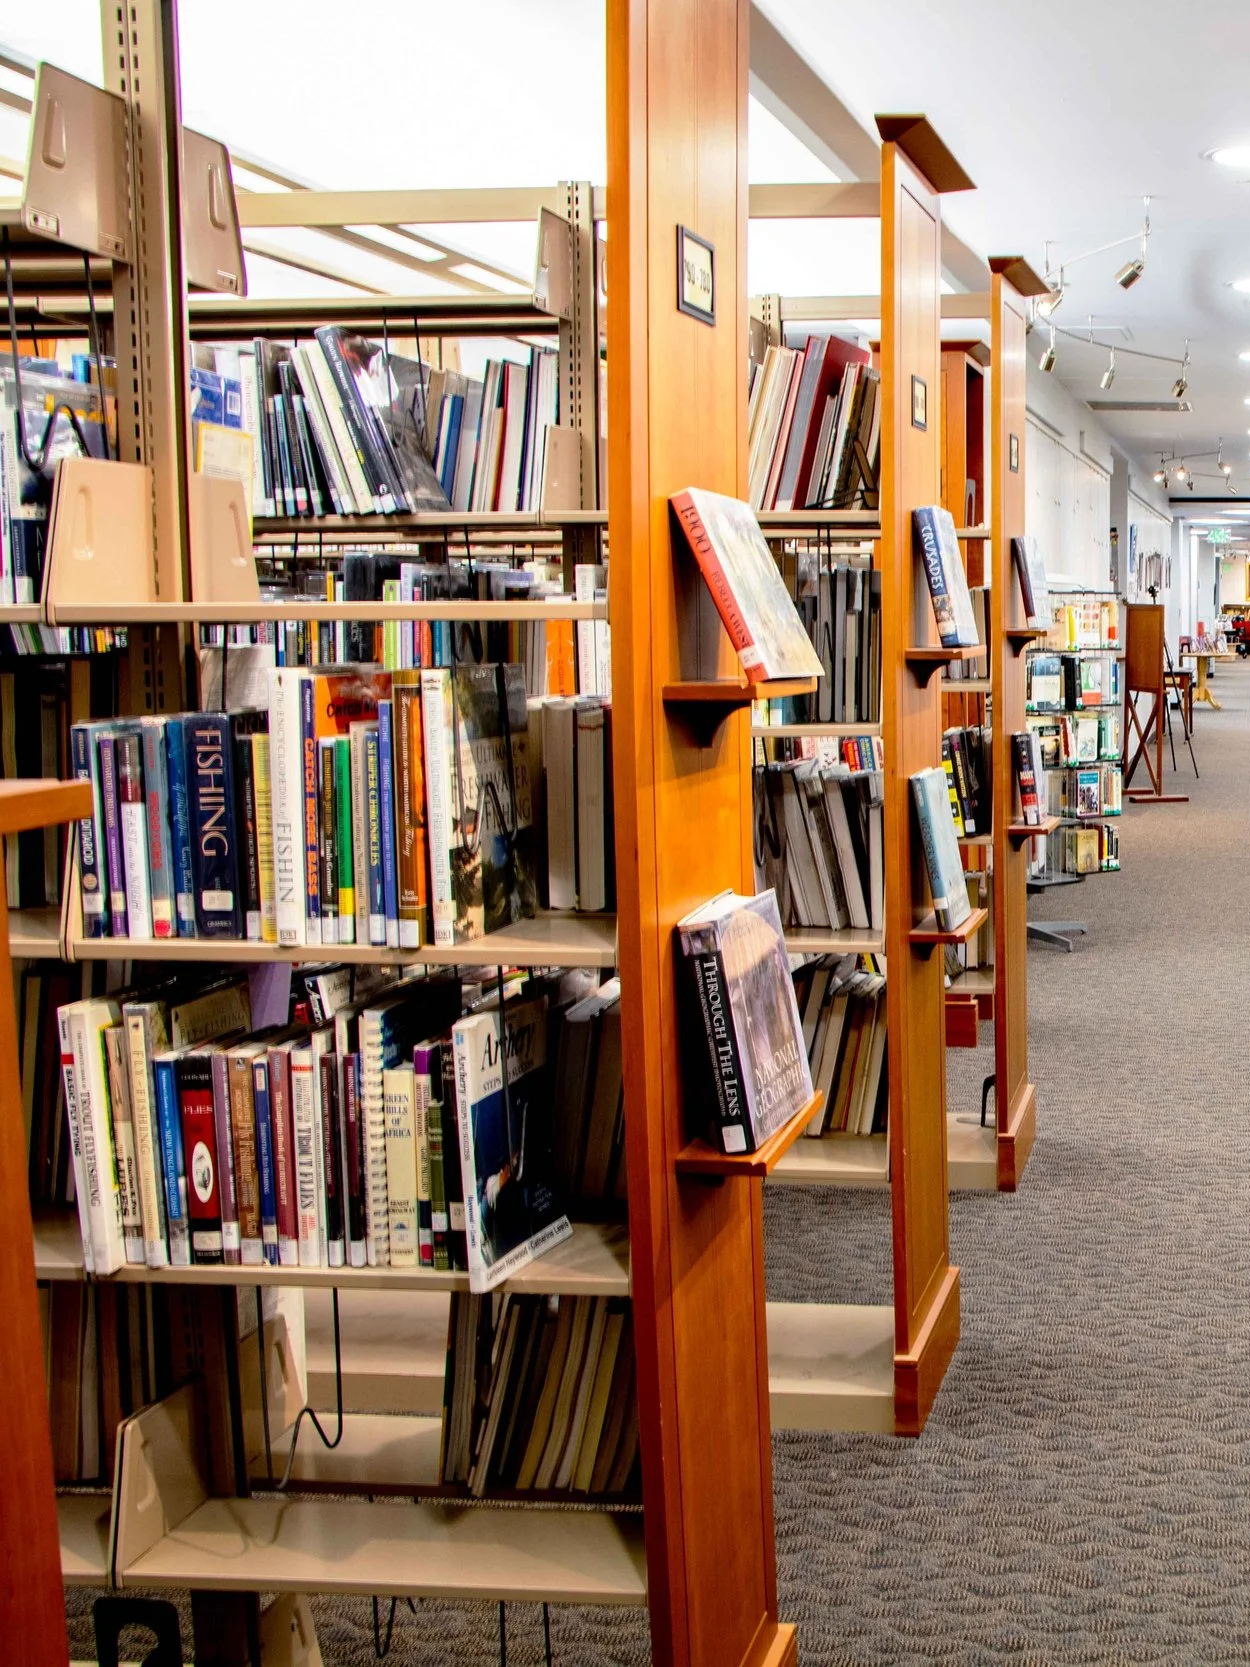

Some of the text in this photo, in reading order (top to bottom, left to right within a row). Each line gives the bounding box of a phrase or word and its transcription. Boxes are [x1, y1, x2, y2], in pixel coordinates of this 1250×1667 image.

[681, 505, 749, 649] 1900 REBECCA WEST
[921, 526, 944, 590] CRUSADES
[195, 730, 229, 857] FISHING
[304, 738, 317, 896] CATCH MORE BASS
[369, 791, 379, 867] CHRONICLES
[703, 956, 727, 1040] THROUGH
[457, 1052, 468, 1094] Archery
[718, 1041, 736, 1078] THE
[755, 1041, 799, 1090] NATIONAL
[65, 1068, 75, 1099] BASIC
[384, 1094, 409, 1103] GREEN
[725, 1079, 741, 1118] LENS
[755, 1064, 808, 1120] GEOGRAPHIC
[184, 1105, 213, 1115] FLIES
[386, 1106, 408, 1115] HILLS
[392, 1117, 401, 1126] OF
[81, 1091, 101, 1208] TROUT FLYFISHING
[384, 1128, 412, 1138] AFRICA
[554, 1219, 569, 1236] Lewis
